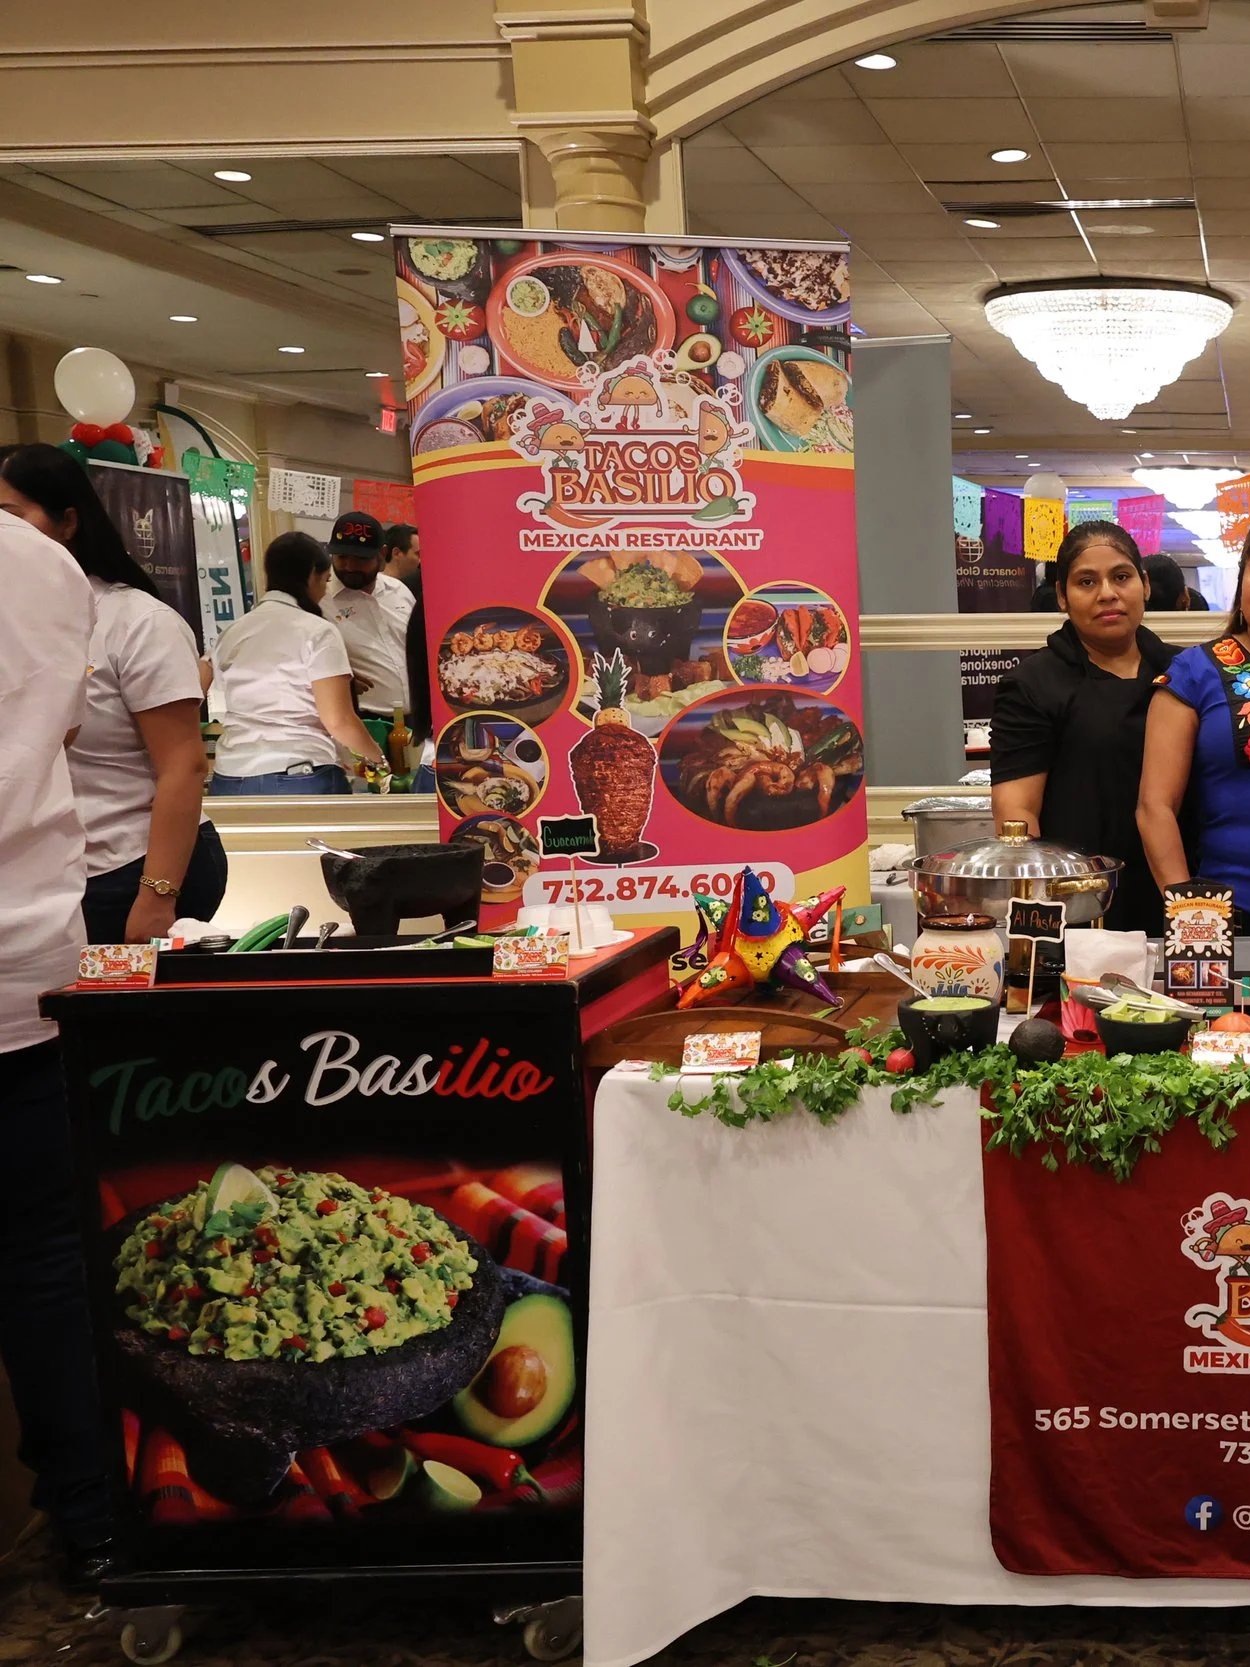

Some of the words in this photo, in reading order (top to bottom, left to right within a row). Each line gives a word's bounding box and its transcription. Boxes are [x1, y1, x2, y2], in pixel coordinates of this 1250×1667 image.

[584, 441, 699, 473] TACOS
[549, 467, 737, 505] BASILIO
[523, 533, 620, 548] MEXICAN
[626, 532, 760, 547] RESTAURANT
[89, 1057, 291, 1136] Tacos
[300, 1030, 555, 1107] Basilio
[1035, 1406, 1091, 1431] 565
